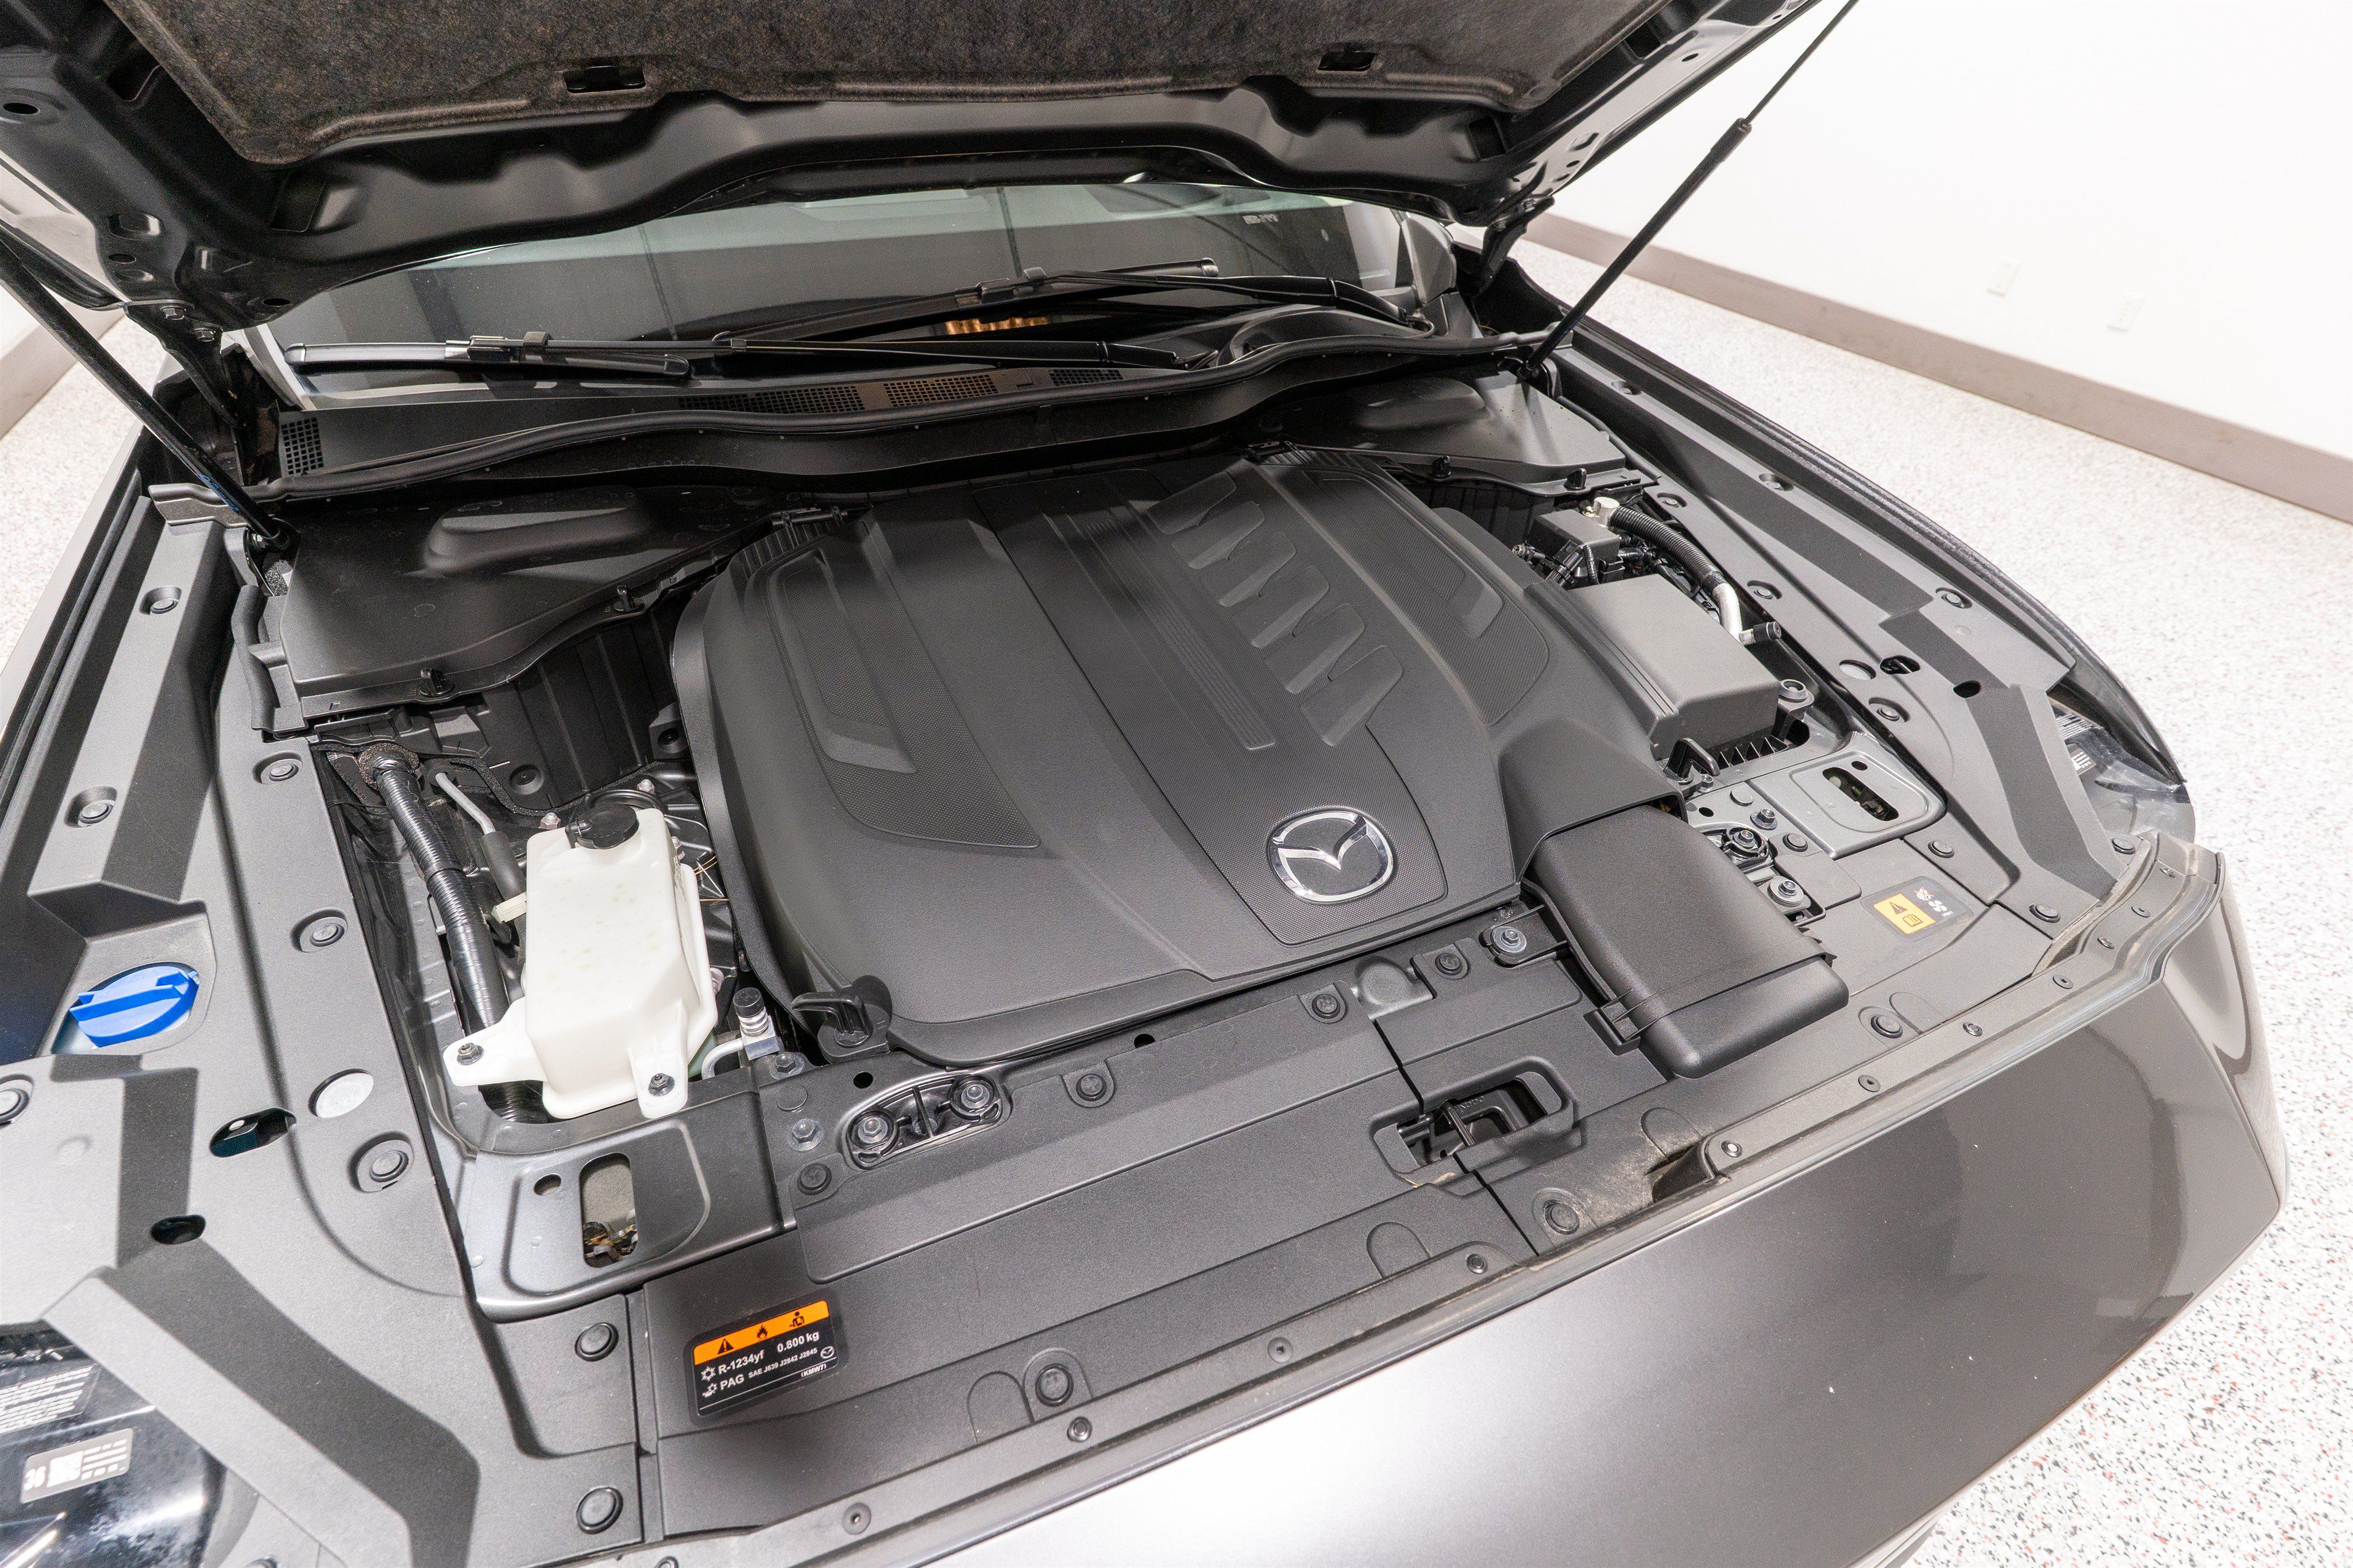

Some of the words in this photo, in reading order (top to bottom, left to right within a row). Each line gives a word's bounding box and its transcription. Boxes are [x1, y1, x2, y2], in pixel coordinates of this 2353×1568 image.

[718, 1350, 765, 1375] R-1234yf
[777, 1335, 805, 1353] 0.800
[806, 1331, 820, 1342] kg
[720, 1374, 745, 1391] PAG
[748, 1368, 763, 1378] SAE
[763, 1362, 779, 1373] J639
[780, 1354, 799, 1367] J2842
